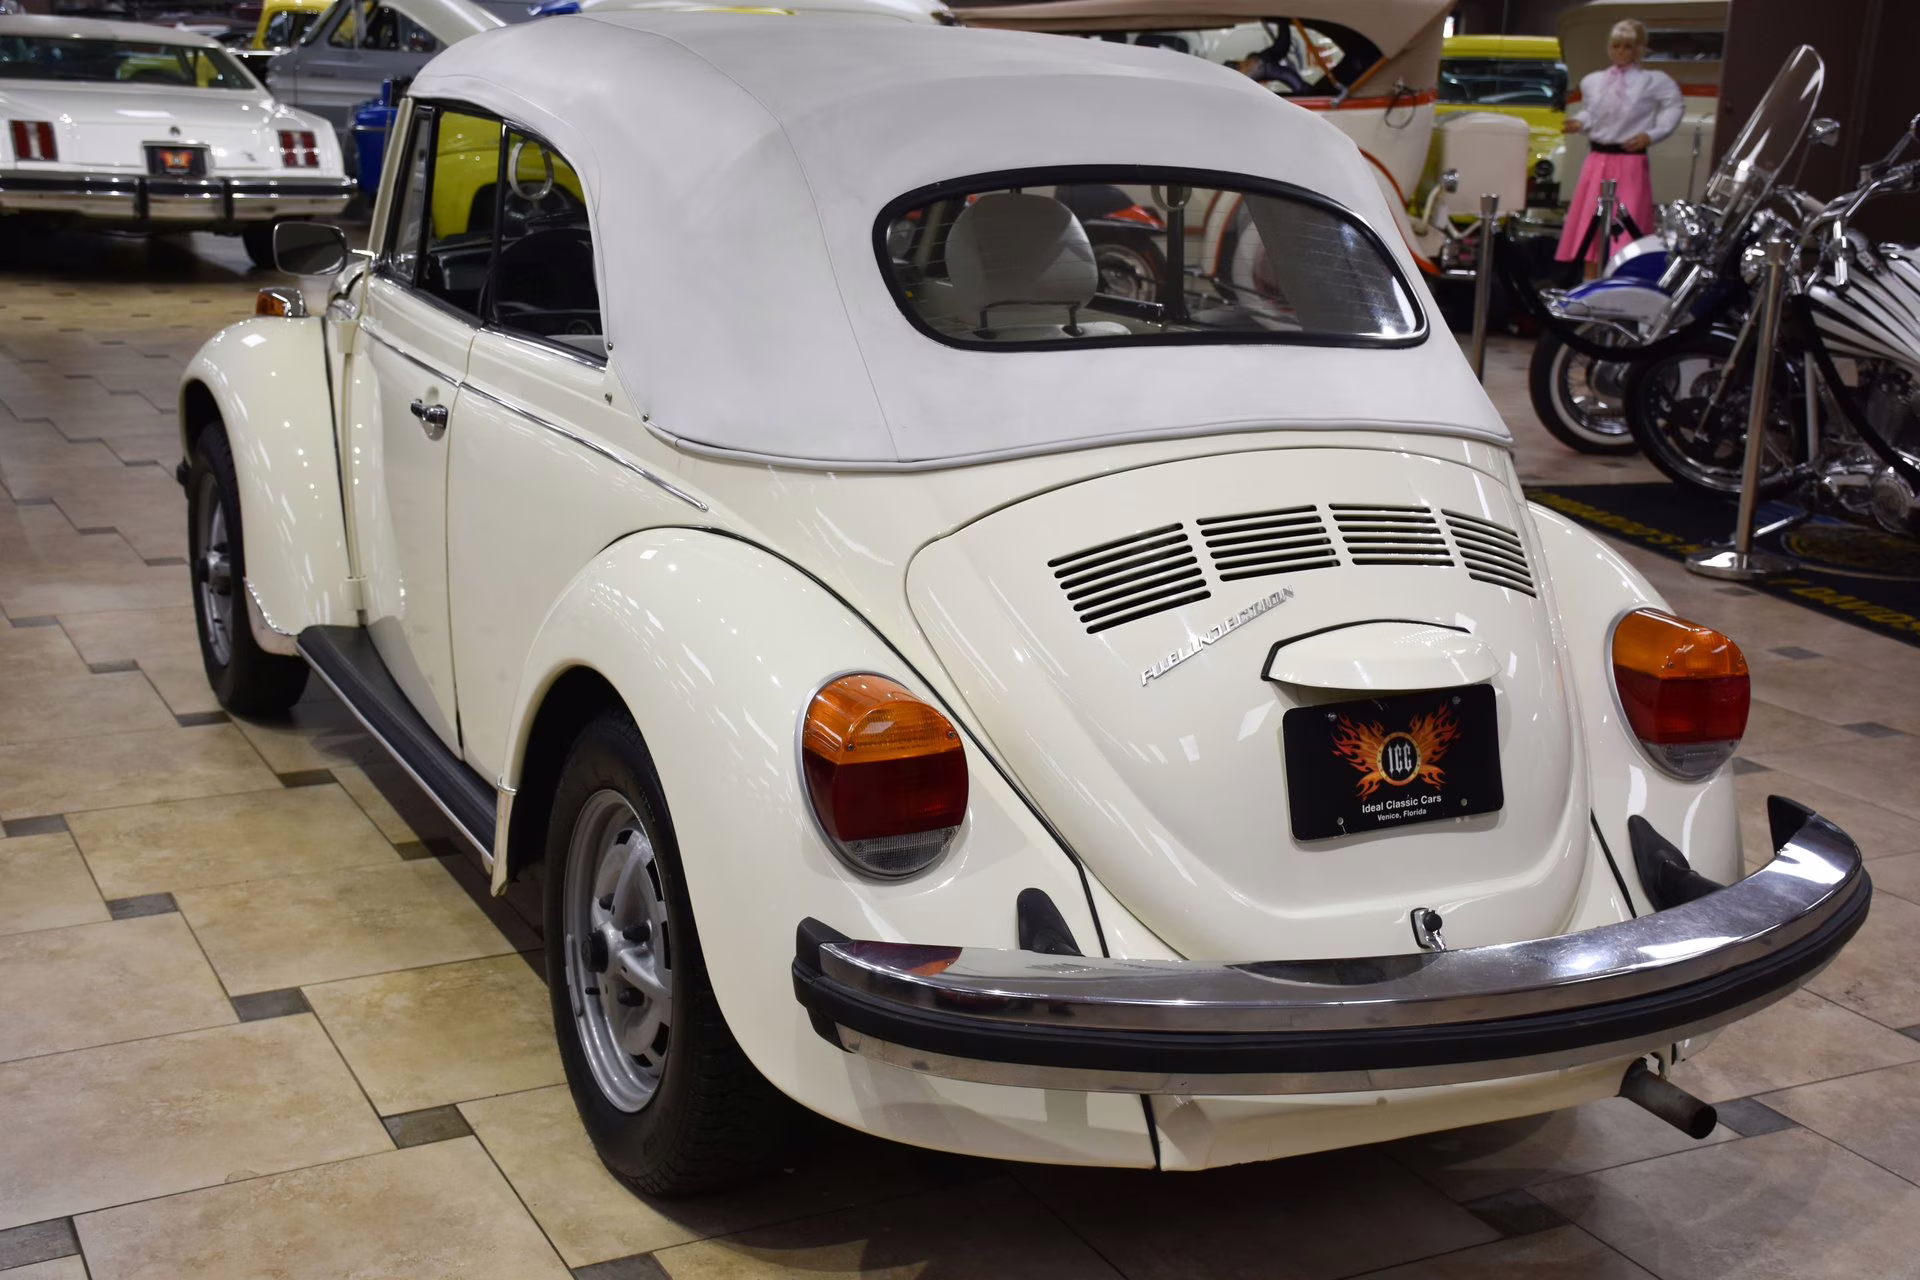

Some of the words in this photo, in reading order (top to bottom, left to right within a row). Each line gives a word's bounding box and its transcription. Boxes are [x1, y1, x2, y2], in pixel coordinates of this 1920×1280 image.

[1141, 647, 1196, 687] FUEL
[1190, 584, 1295, 652] INJECTION
[1362, 802, 1384, 813] Ideal
[1386, 797, 1418, 809] Classic
[1420, 794, 1442, 804] Cars
[1377, 813, 1402, 821] Venice,
[1403, 808, 1427, 817] Florida
